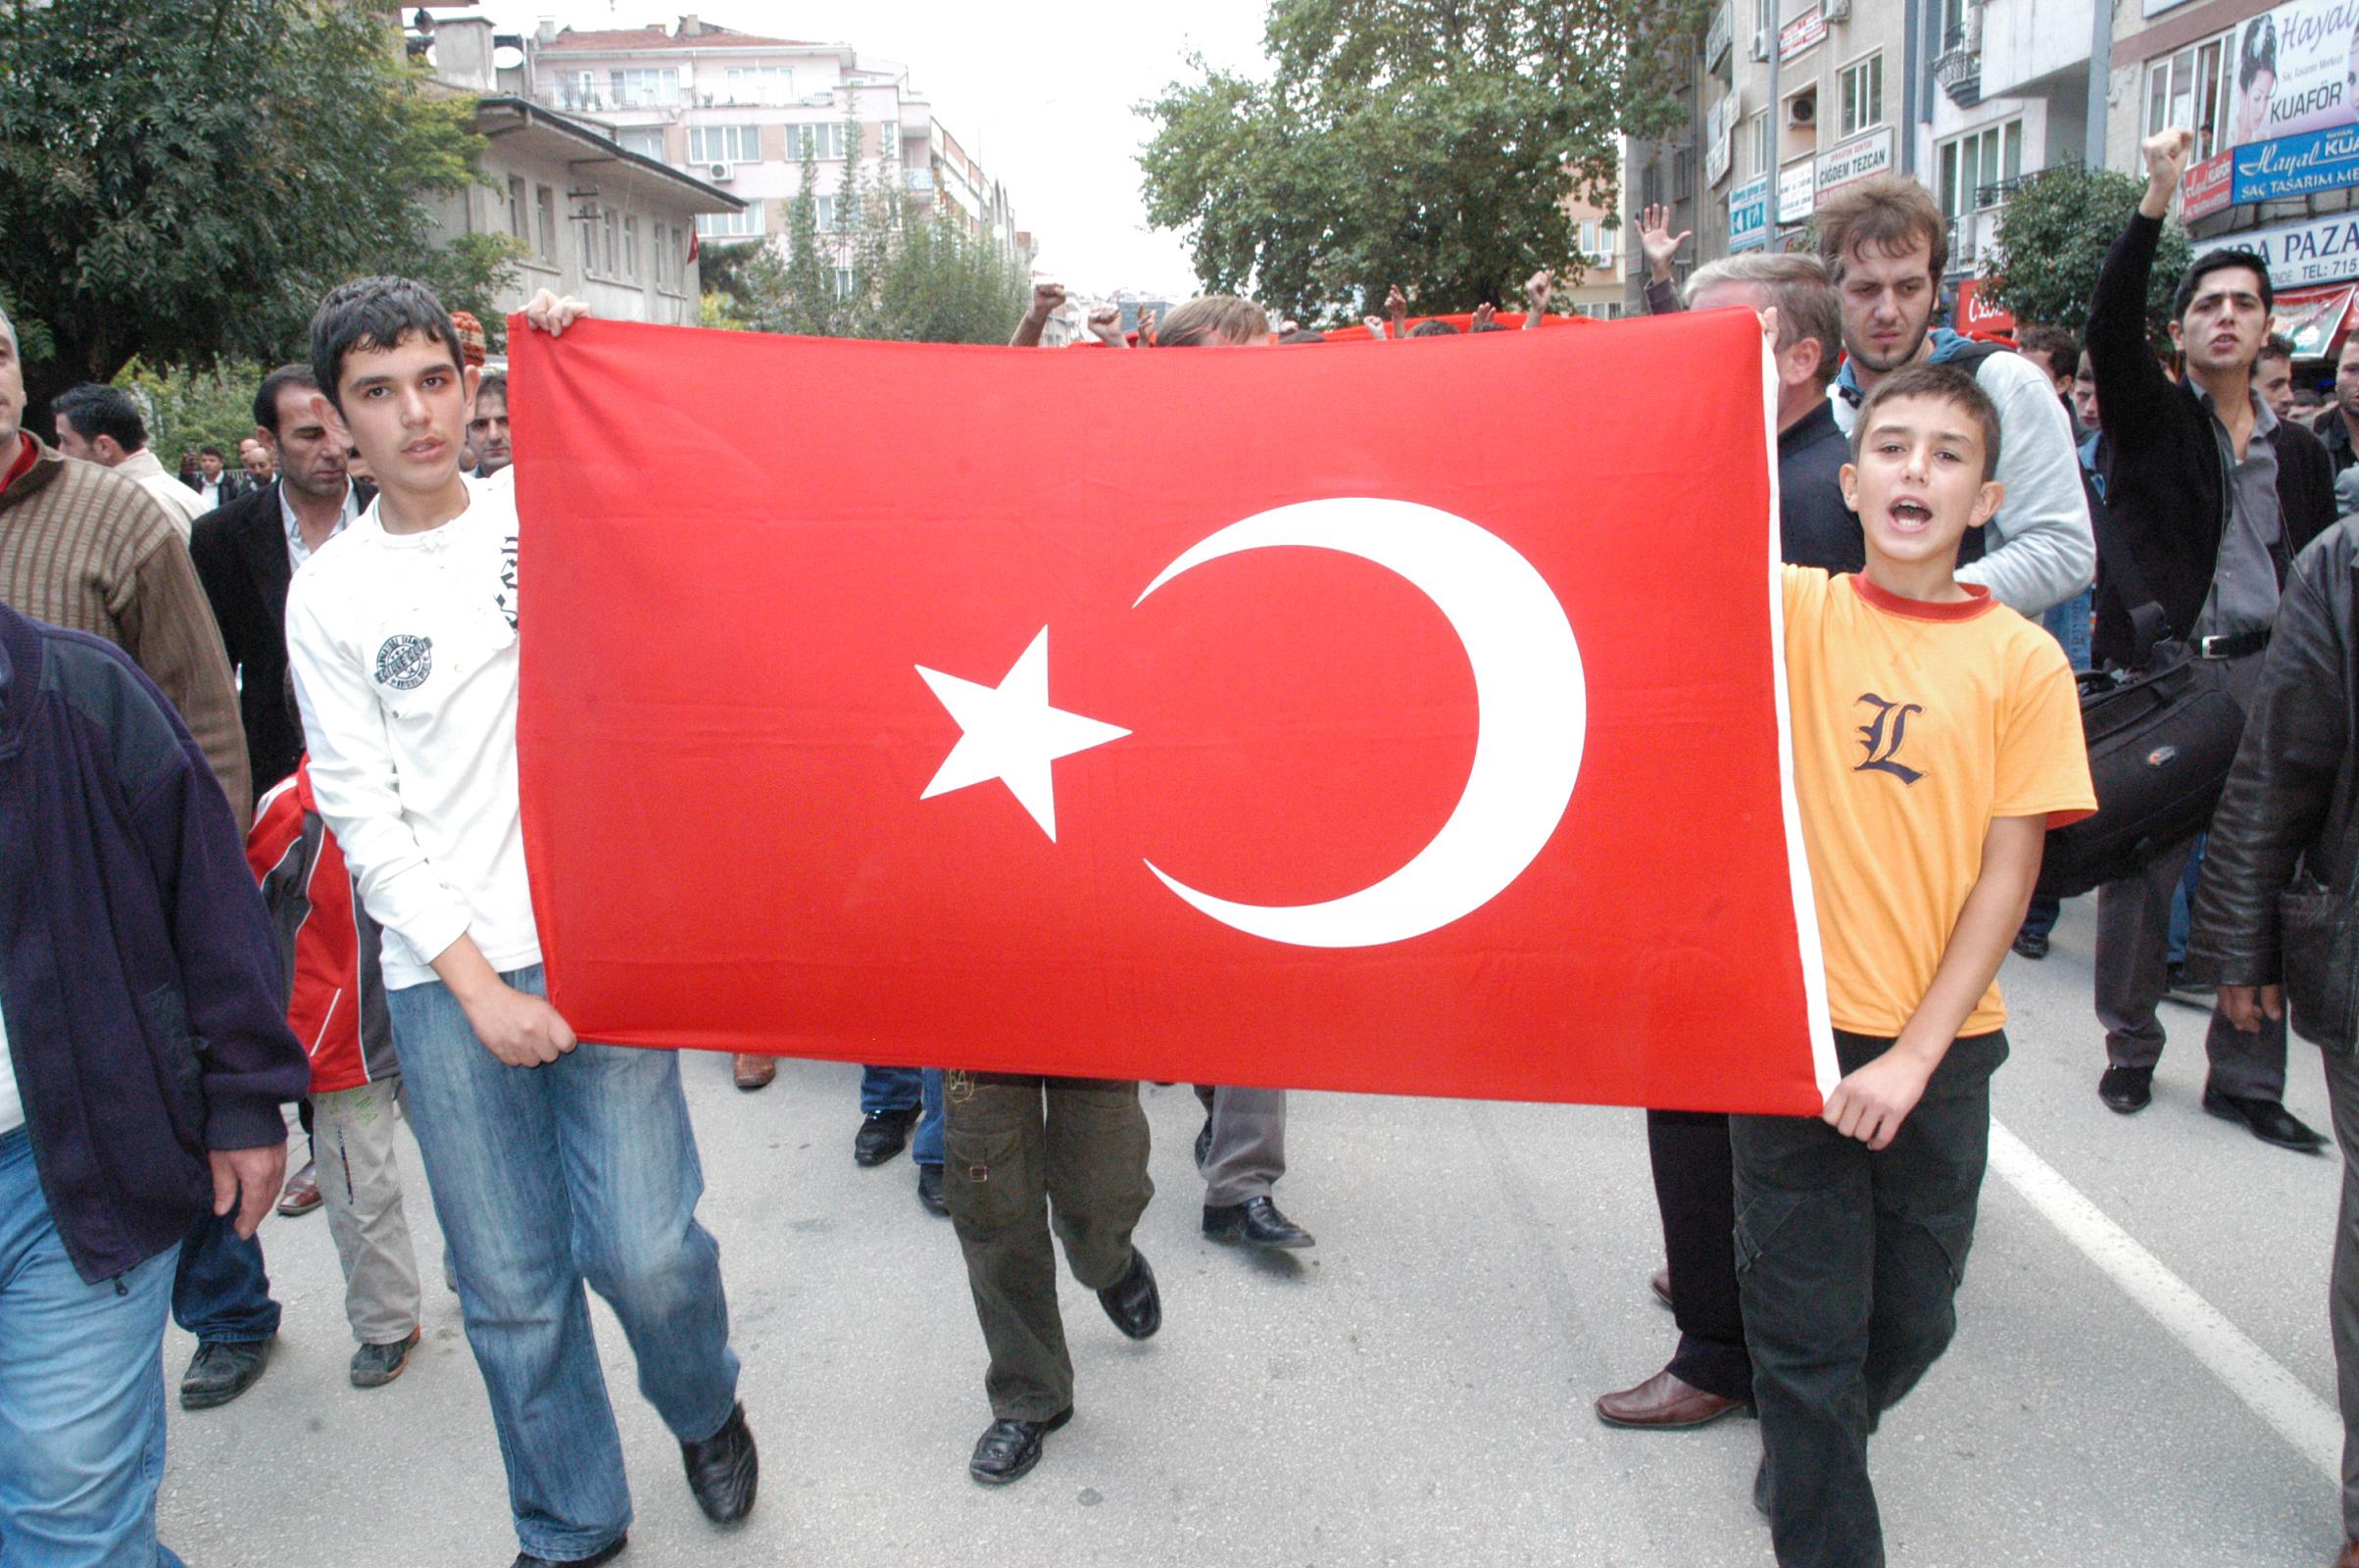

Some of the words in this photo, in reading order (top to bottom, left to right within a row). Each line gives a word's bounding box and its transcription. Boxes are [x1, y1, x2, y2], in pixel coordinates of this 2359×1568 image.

[2280, 0, 2355, 55] Hayal
[2270, 79, 2343, 124] KUAFÖR
[1852, 147, 1886, 174] TEZCAN
[2238, 142, 2321, 176] Hayal
[2241, 182, 2267, 199] SAÇ
[2270, 171, 2334, 193] TASARIM
[2284, 220, 2359, 264] PAZA
[2302, 263, 2329, 280] TEL:
[2333, 258, 2357, 275] 715
